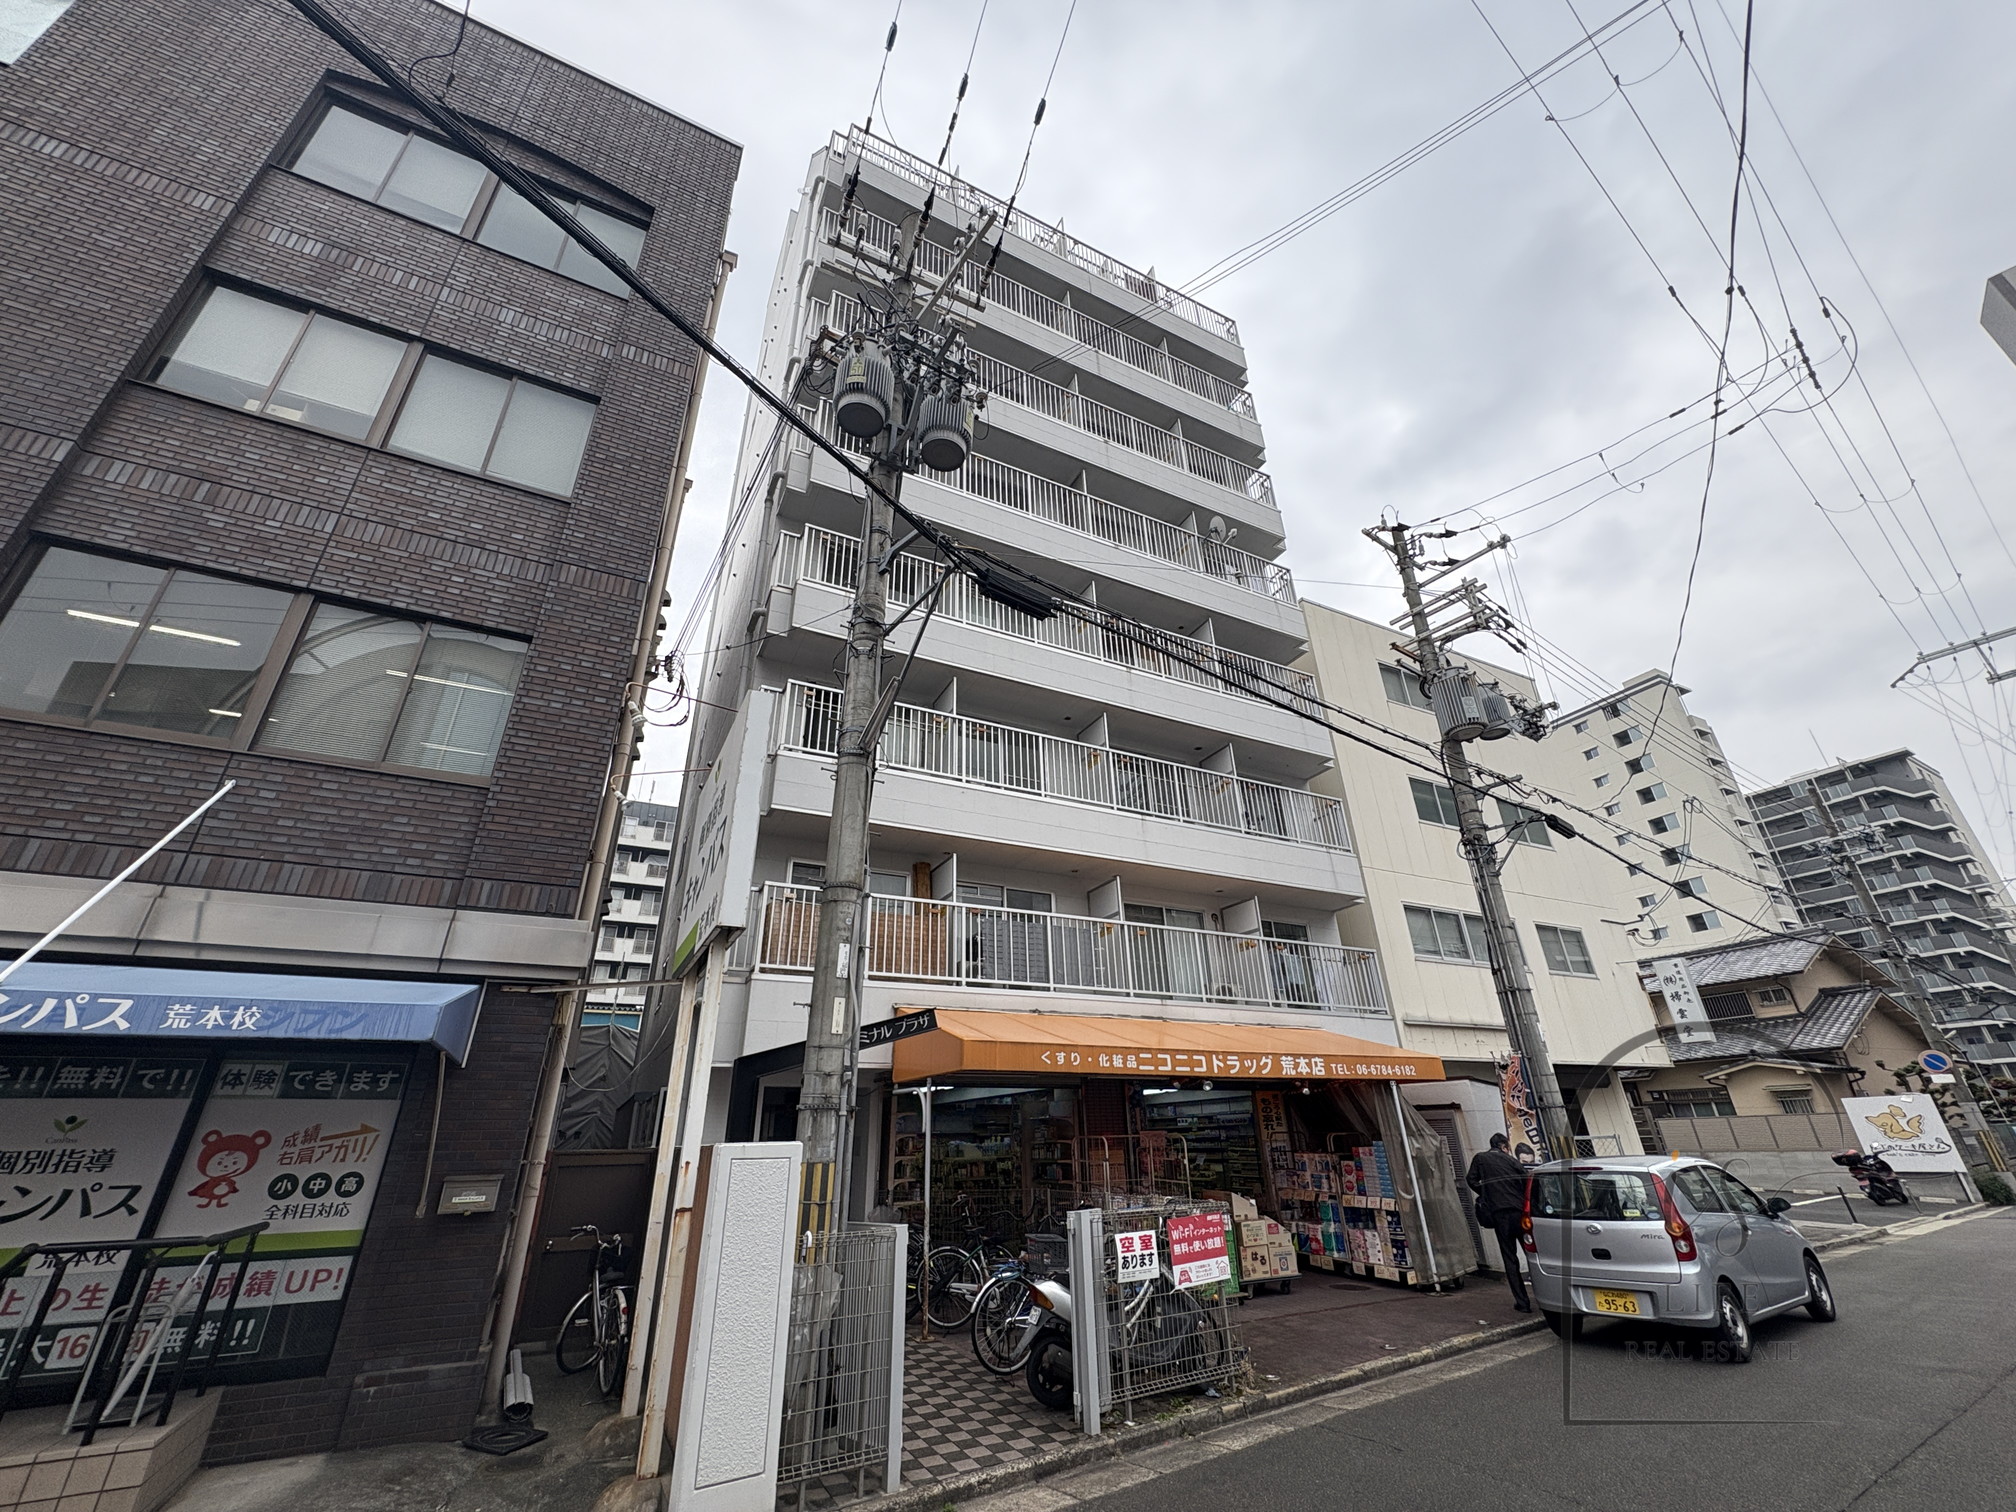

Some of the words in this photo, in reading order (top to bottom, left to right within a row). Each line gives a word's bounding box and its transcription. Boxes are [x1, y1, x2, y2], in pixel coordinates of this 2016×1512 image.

[159, 1004, 263, 1030] 荒本校
[1041, 1052, 1137, 1069] くすり・化粧品
[1138, 1053, 1273, 1074] ニコニコドラッグ
[1280, 1056, 1326, 1076] 荒本店
[281, 1123, 323, 1150] 成績
[262, 1202, 352, 1220] 全科目対応
[1119, 1234, 1154, 1254] 空室
[1121, 1251, 1155, 1270] あります
[1604, 1298, 1637, 1313] 95-63
